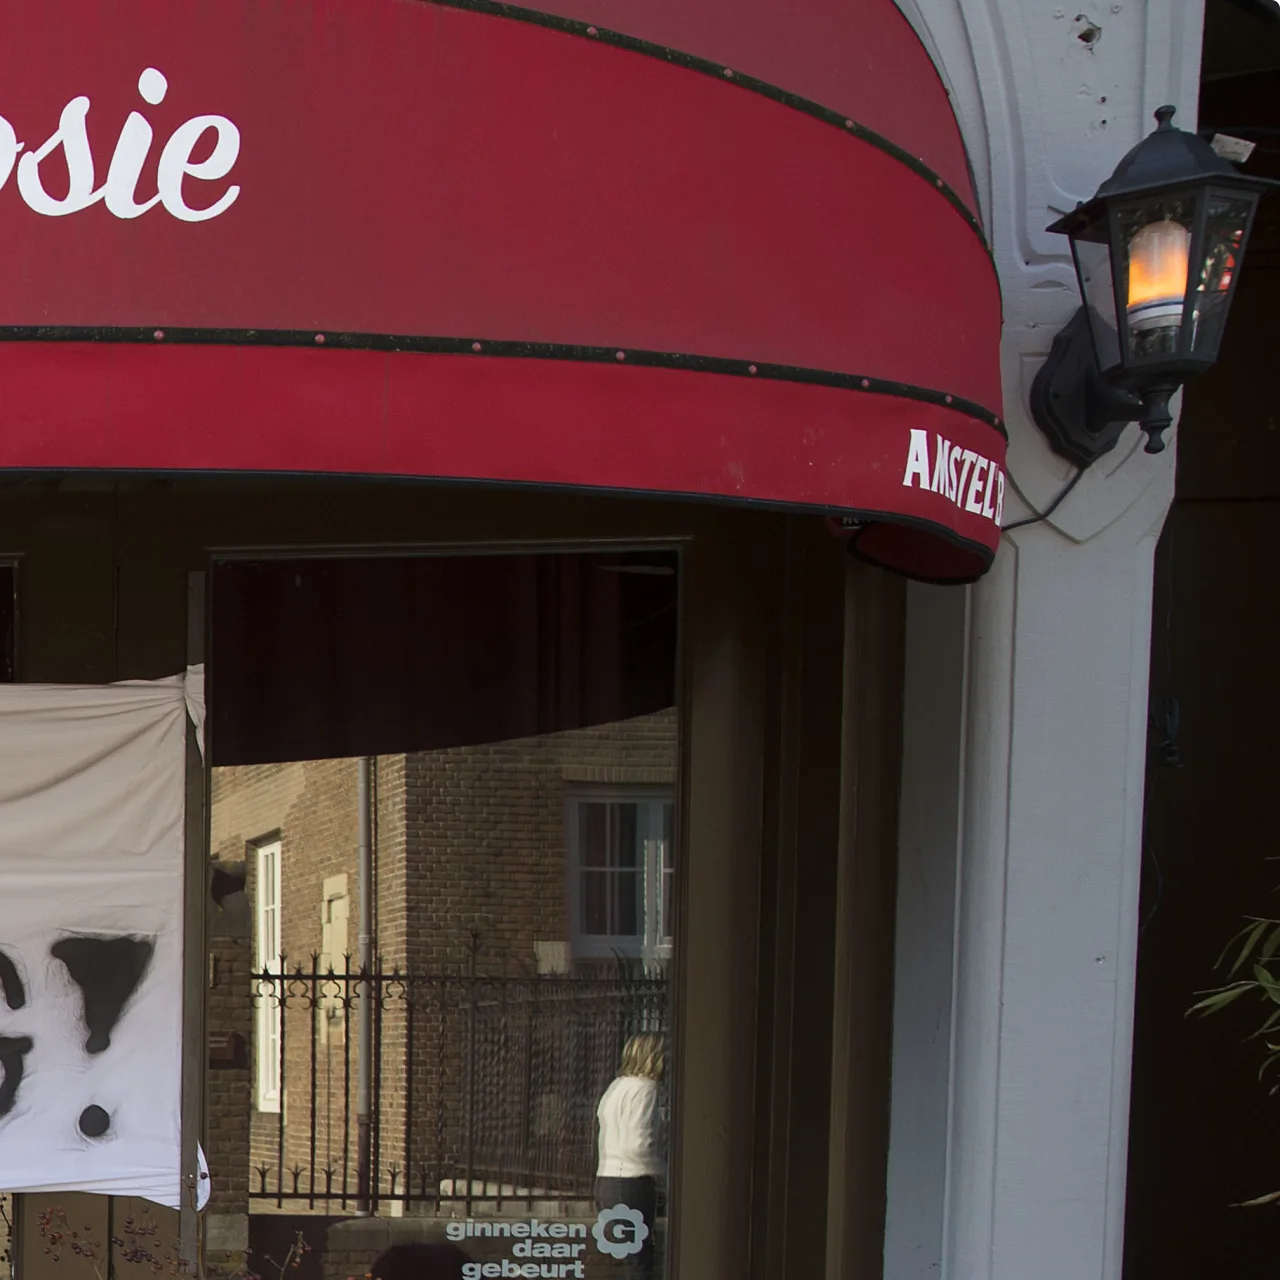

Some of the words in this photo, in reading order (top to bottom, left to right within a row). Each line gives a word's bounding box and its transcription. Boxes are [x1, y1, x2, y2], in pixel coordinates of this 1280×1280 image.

[903, 428, 996, 520] AMSTEL
[446, 1218, 587, 1242] ginneken
[512, 1239, 586, 1258] daar
